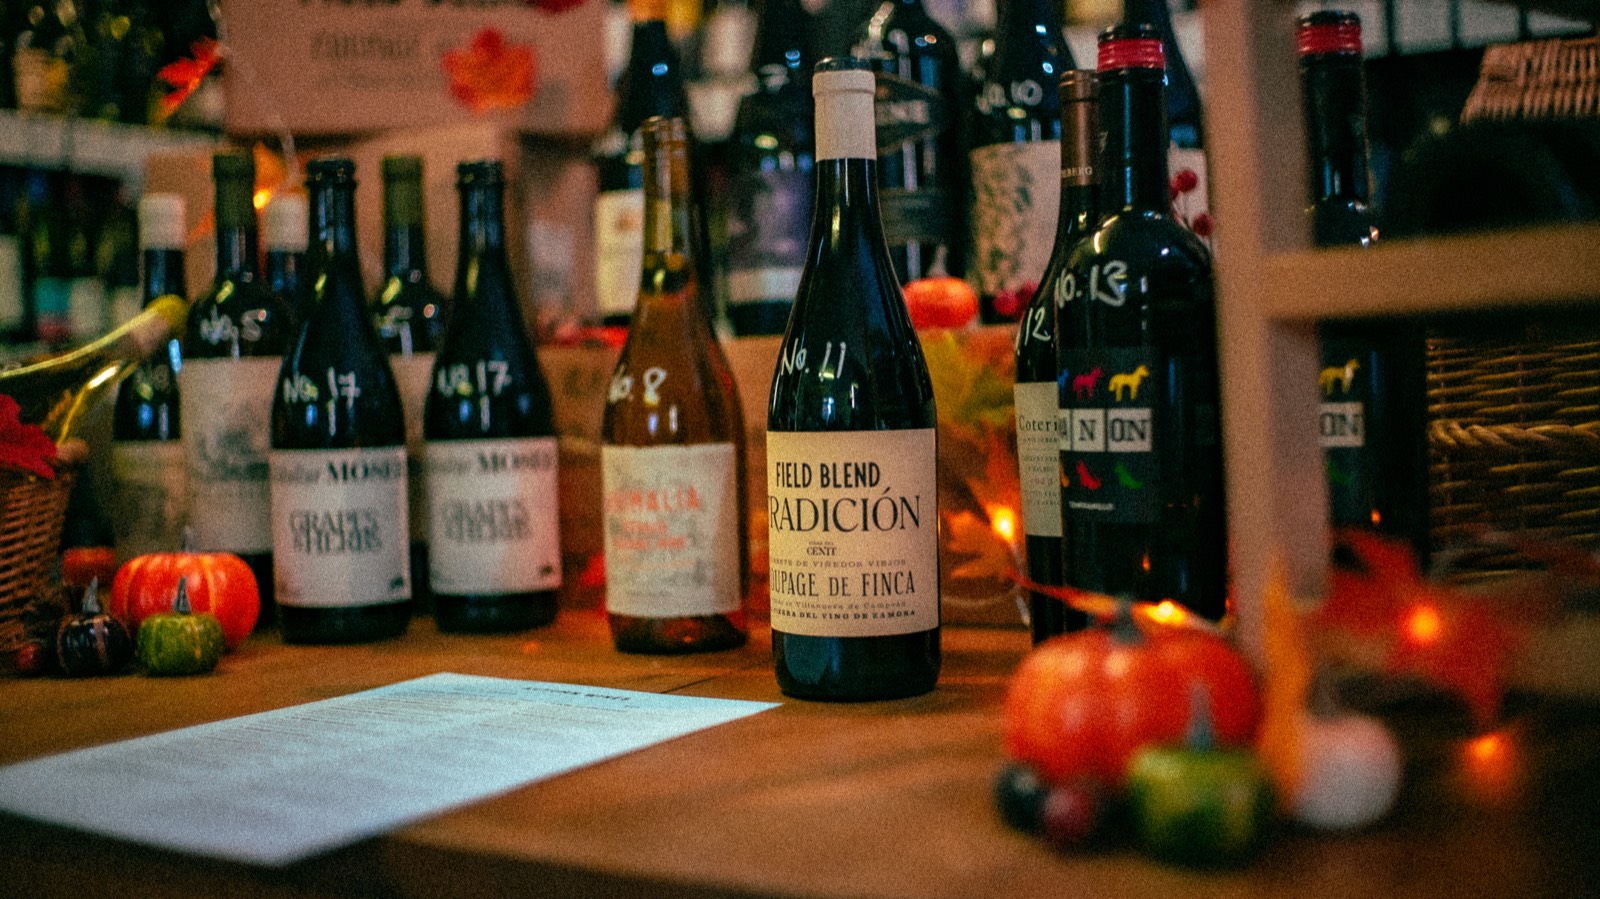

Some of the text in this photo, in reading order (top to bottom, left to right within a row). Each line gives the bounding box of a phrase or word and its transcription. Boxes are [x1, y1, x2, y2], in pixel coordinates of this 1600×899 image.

[1090, 260, 1128, 307] 13
[781, 337, 847, 382] No. 11
[1018, 414, 1058, 432] Coteri
[776, 462, 881, 488] FIELD BLEND
[768, 485, 920, 533] RADICIÓN
[828, 576, 852, 597] DE
[861, 569, 916, 597] FINCA
[799, 611, 818, 620] DEL
[821, 612, 849, 620] VINO
[854, 612, 868, 620] DE
[872, 608, 916, 620] ZAMORA
